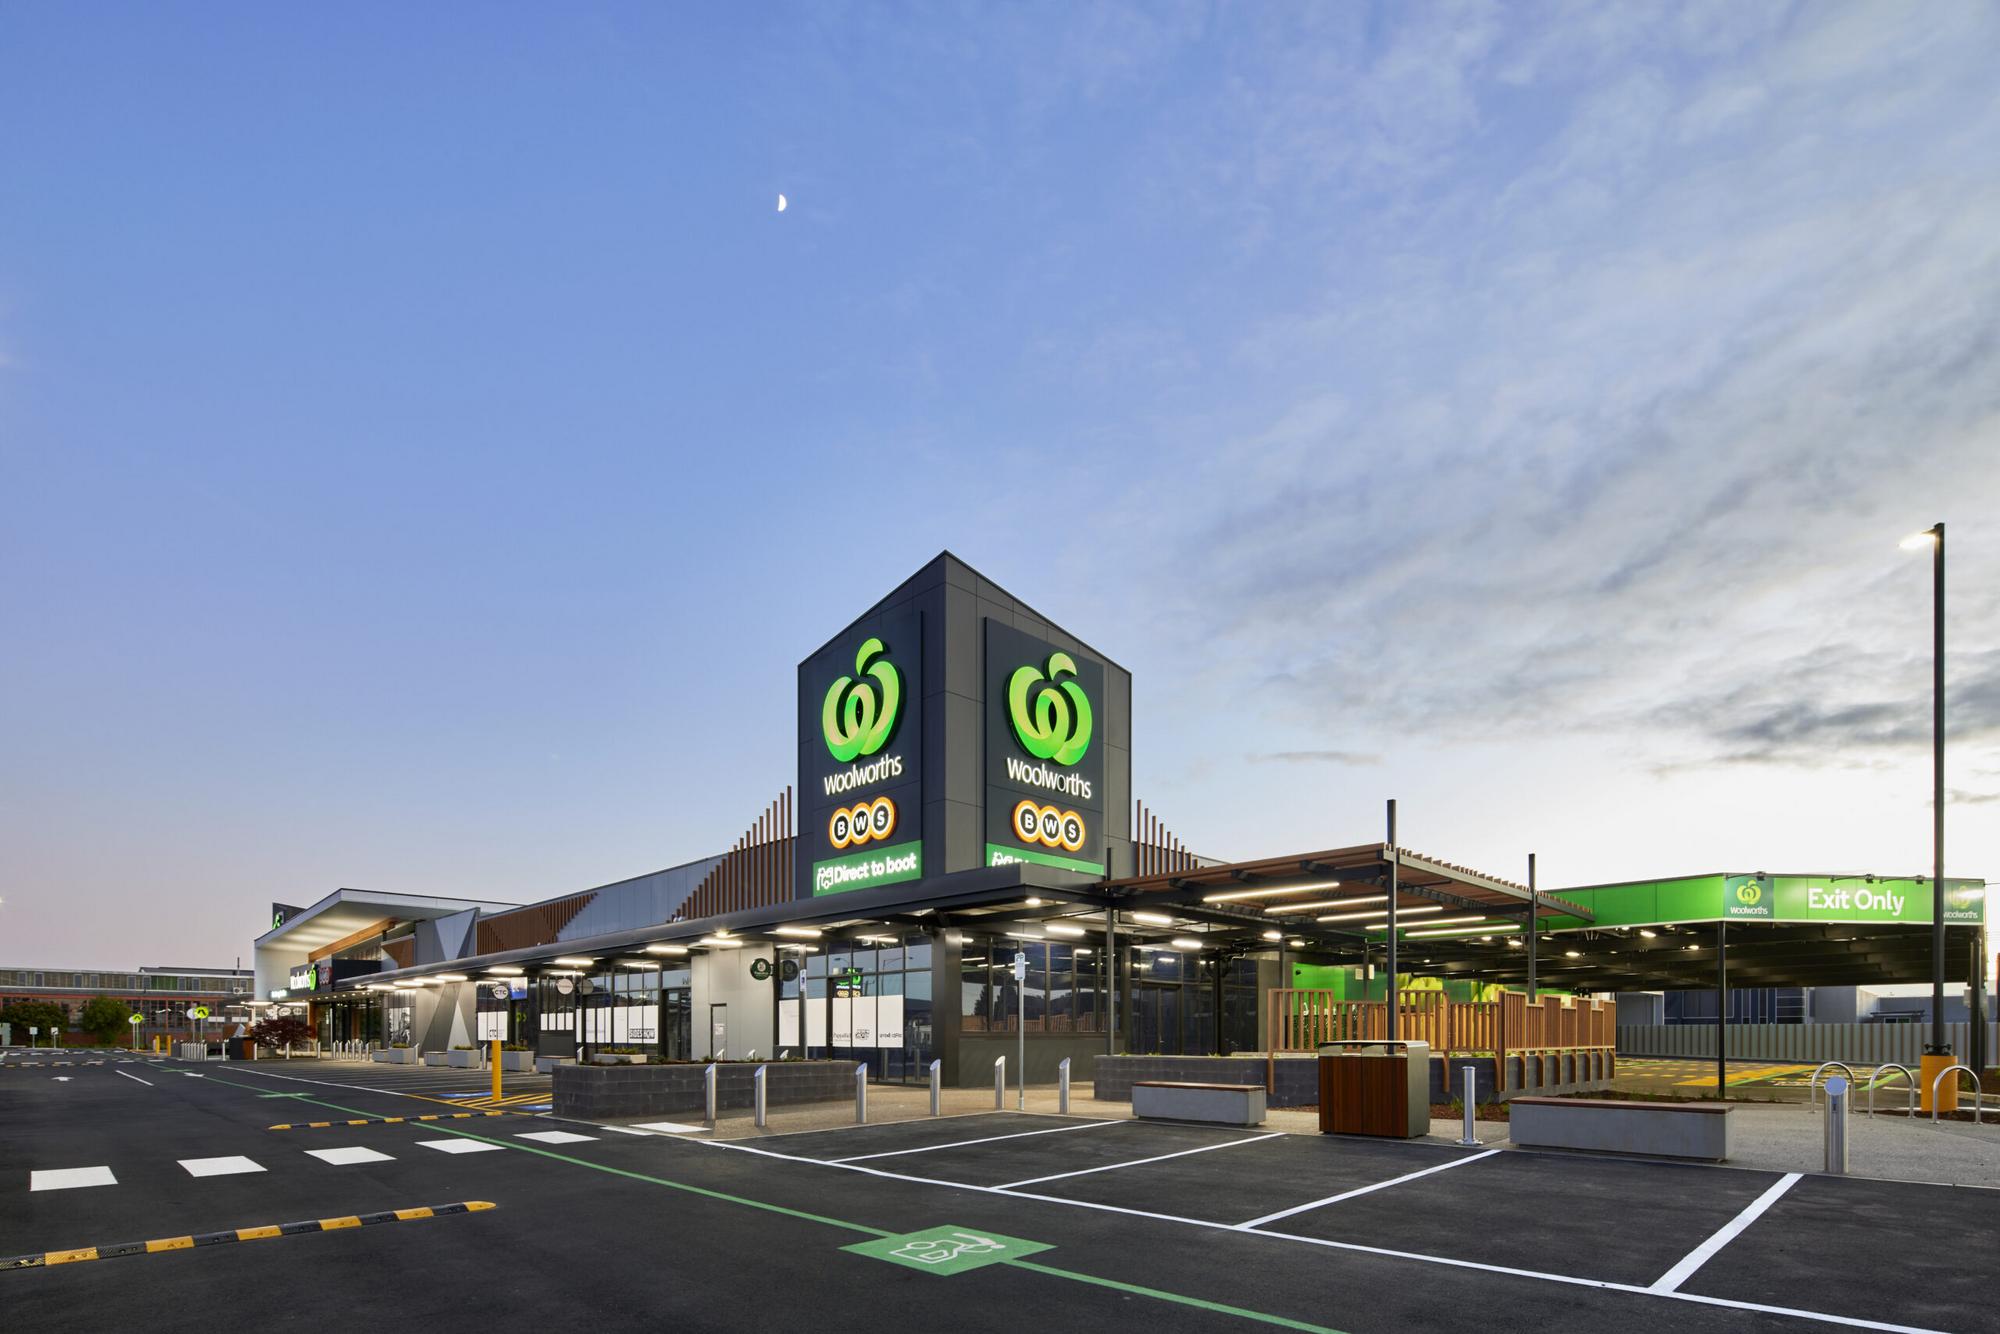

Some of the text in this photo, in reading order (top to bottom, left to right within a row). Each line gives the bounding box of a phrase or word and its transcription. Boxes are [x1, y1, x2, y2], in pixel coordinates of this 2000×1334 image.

[824, 754, 902, 796] Woolworths
[1006, 757, 1092, 799] Woolworths
[834, 806, 888, 840] BWS
[1021, 809, 1080, 842] BWS
[834, 852, 917, 884] Direct to boot
[1729, 905, 1768, 915] Woolworths
[1807, 888, 1905, 917] Exit Only
